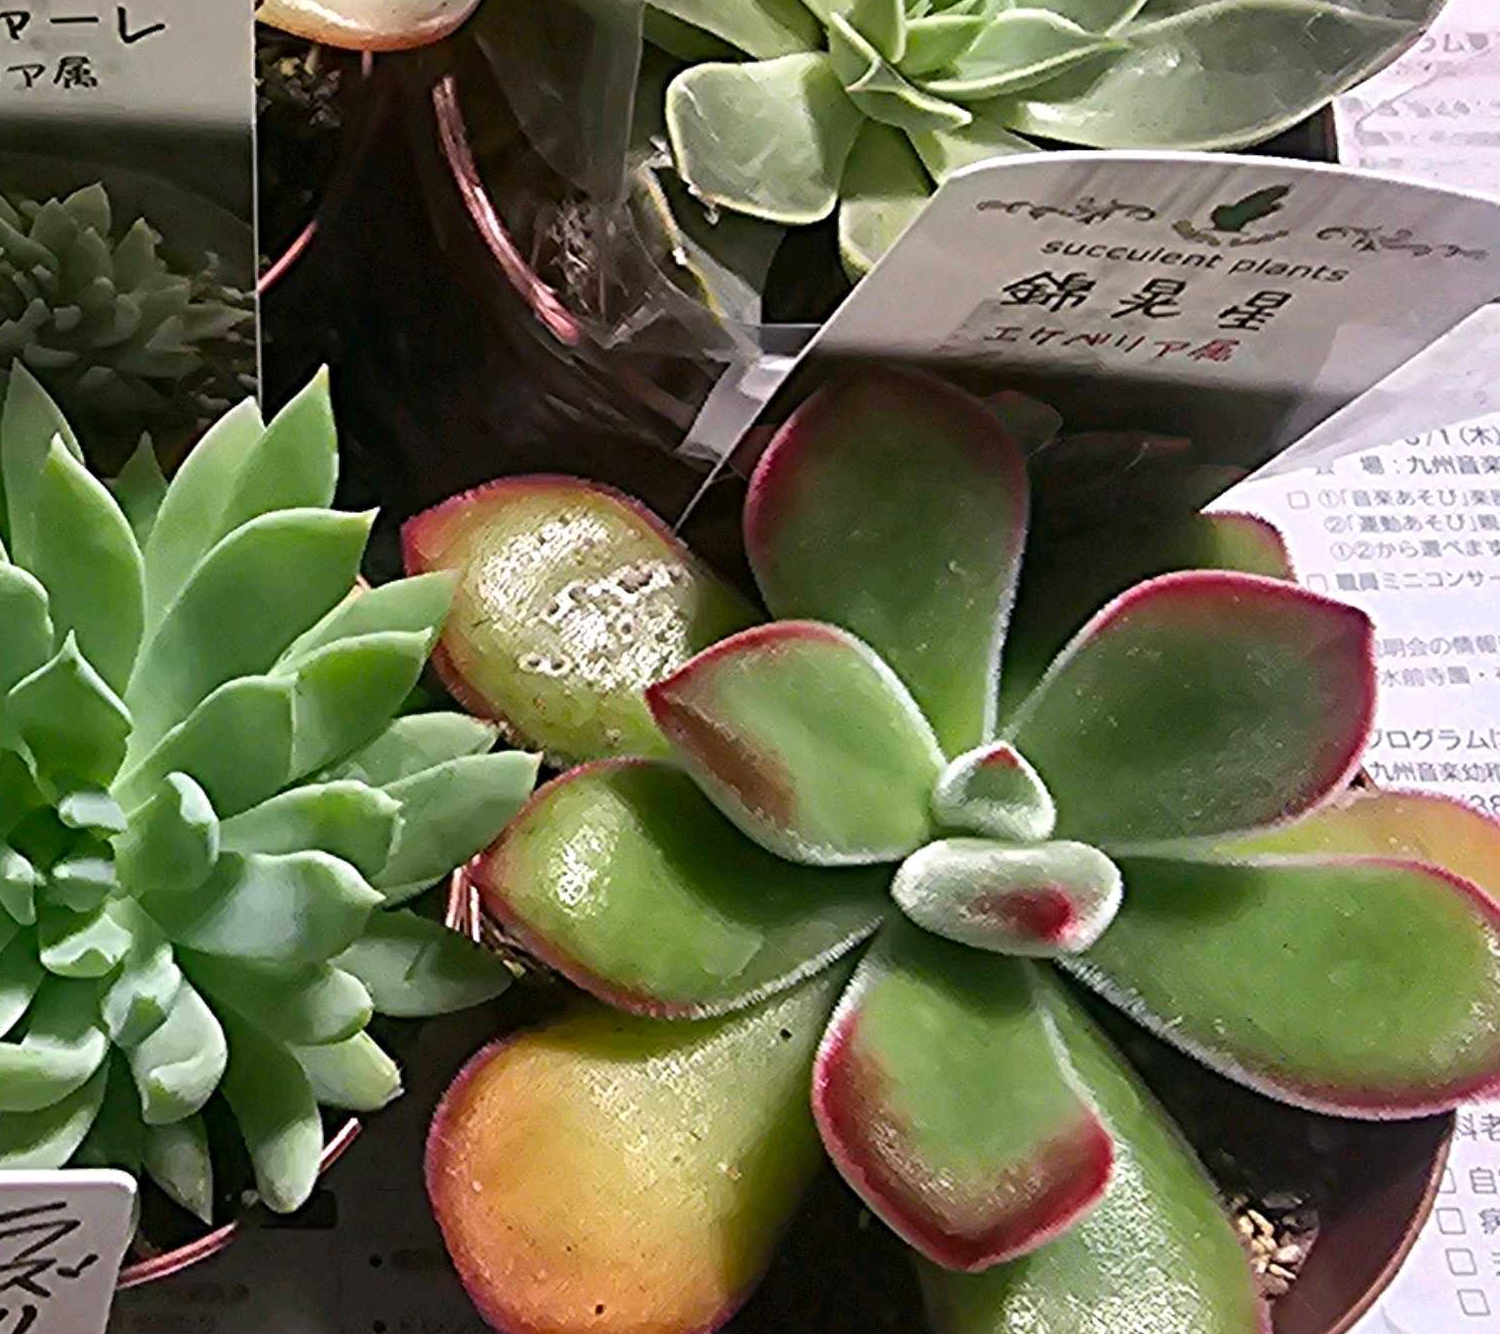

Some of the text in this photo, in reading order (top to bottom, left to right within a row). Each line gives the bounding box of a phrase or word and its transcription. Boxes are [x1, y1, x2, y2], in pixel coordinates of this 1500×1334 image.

[1040, 238, 1350, 284] succulent plants
[998, 269, 1293, 332] 錦晃星
[983, 324, 1241, 364] エケベリア属
